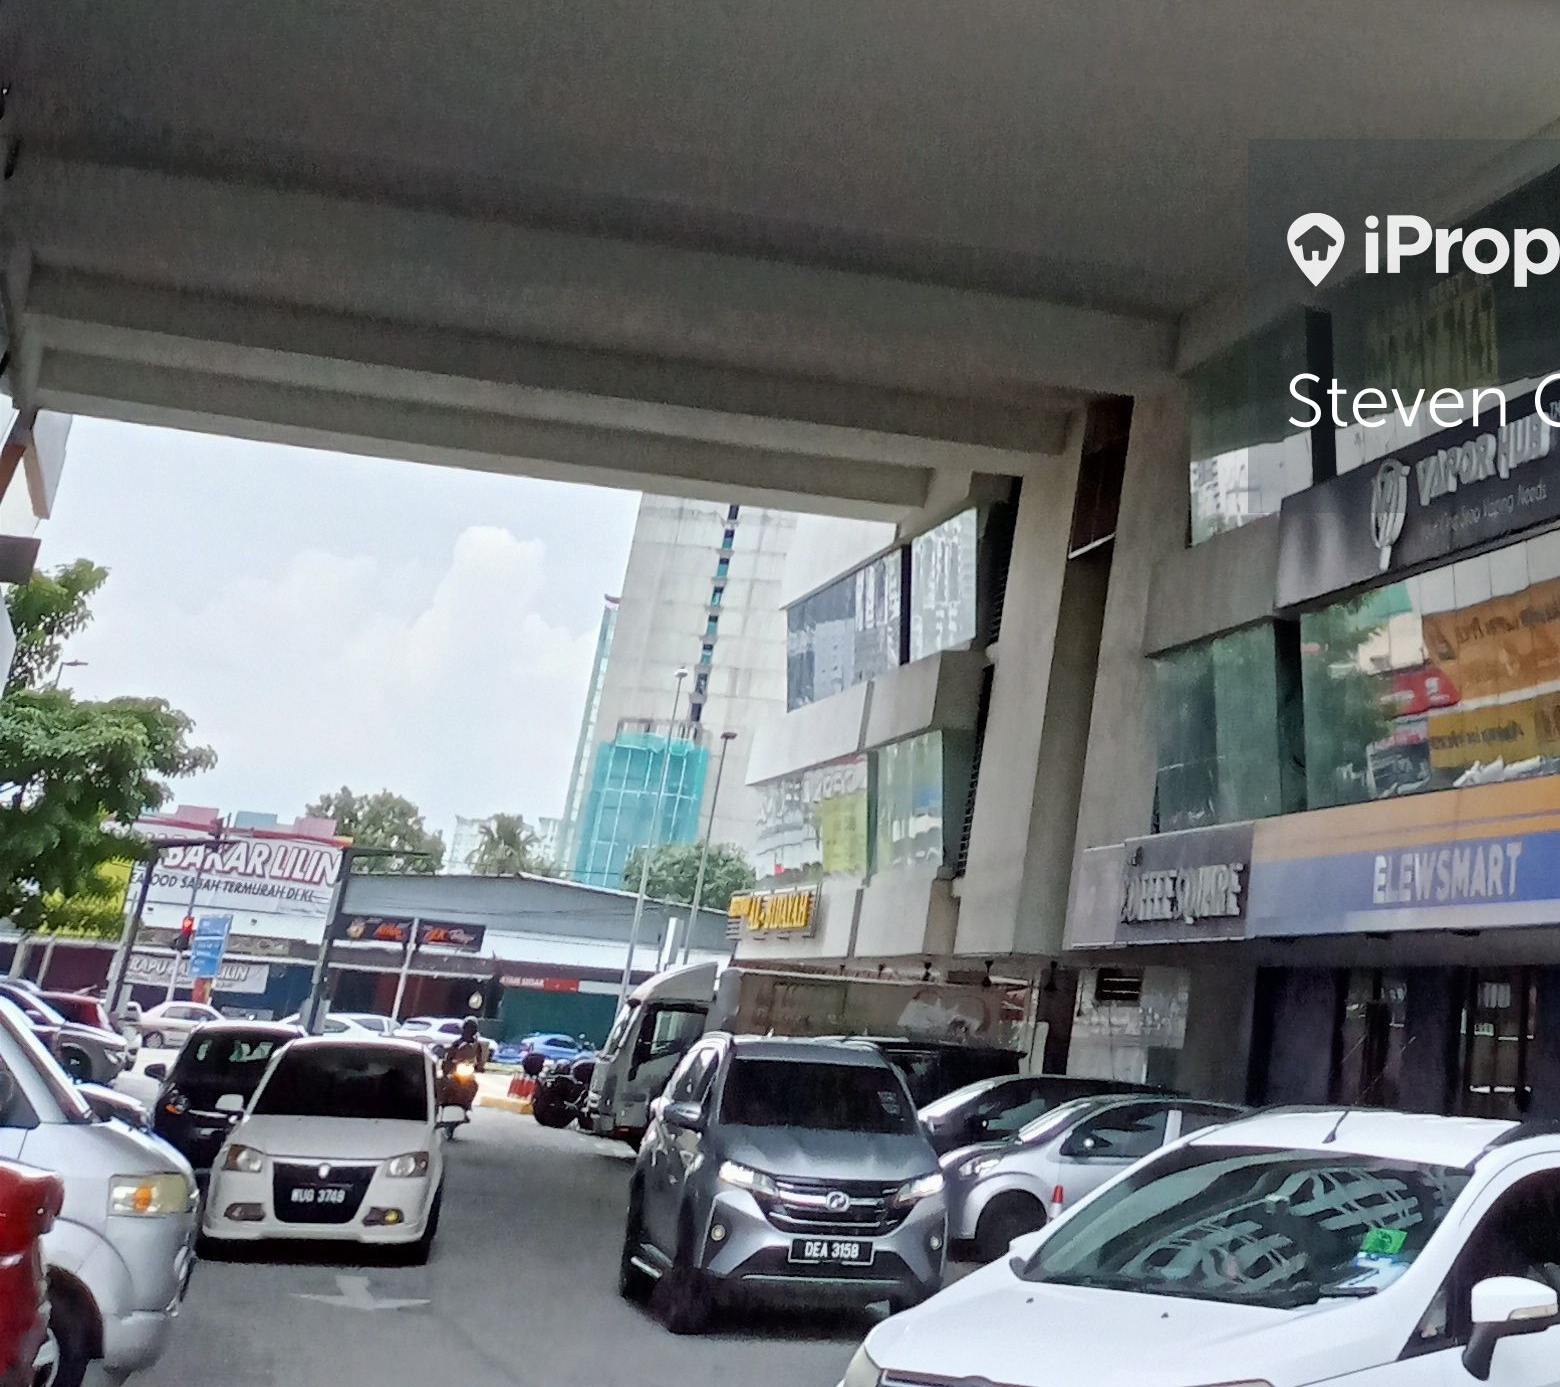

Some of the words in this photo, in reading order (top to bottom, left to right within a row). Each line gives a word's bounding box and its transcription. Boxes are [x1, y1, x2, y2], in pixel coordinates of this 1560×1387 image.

[269, 844, 343, 888] LILIN
[1372, 841, 1524, 905] ELEWSMART
[222, 881, 283, 899] TERMURAH
[804, 1241, 828, 1258] DEA
[831, 1242, 860, 1259] 3158
